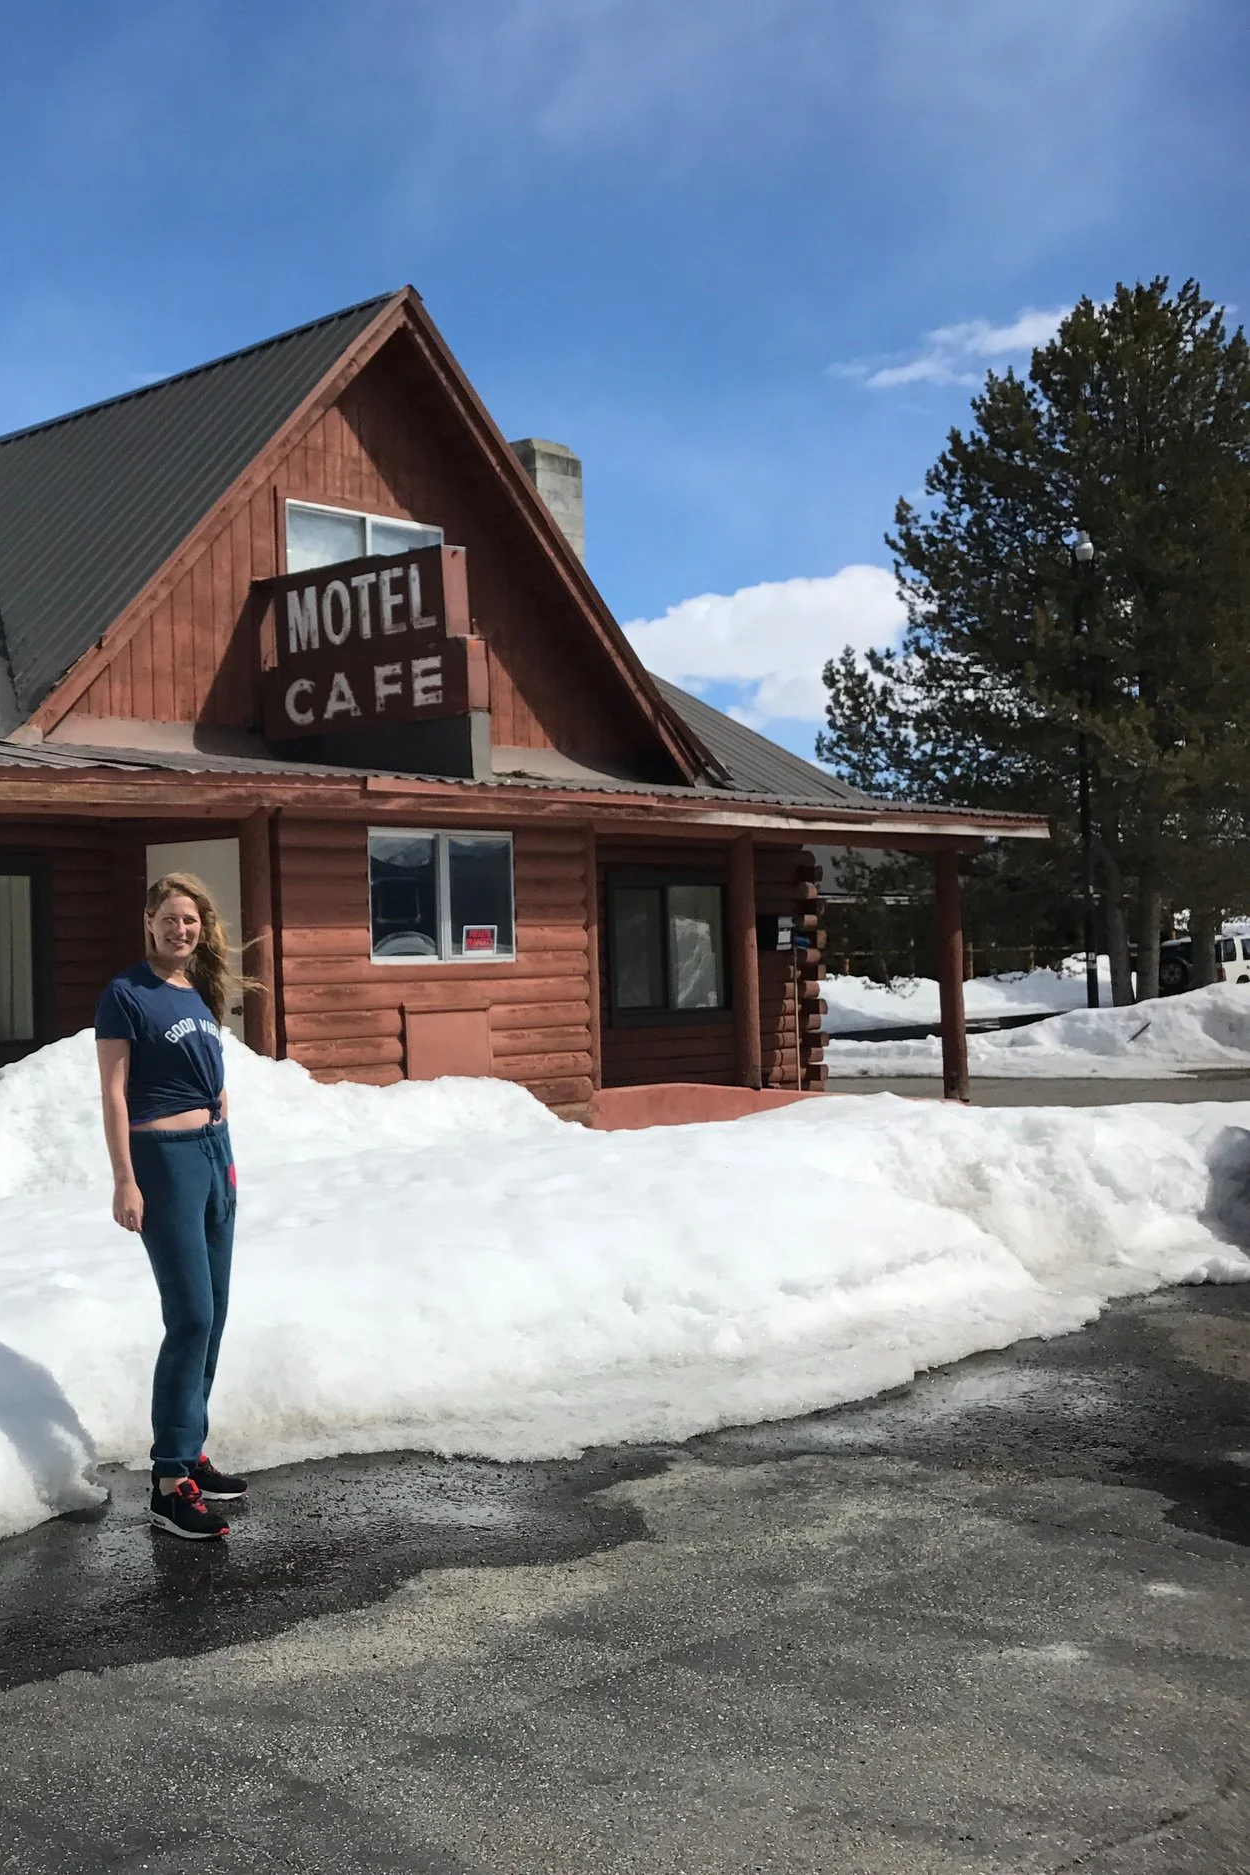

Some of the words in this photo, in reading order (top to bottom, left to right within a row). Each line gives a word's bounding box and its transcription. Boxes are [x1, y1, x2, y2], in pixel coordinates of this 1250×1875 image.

[286, 563, 437, 653] MOTEL
[285, 655, 443, 726] CAFE
[164, 1017, 197, 1043] GOOD
